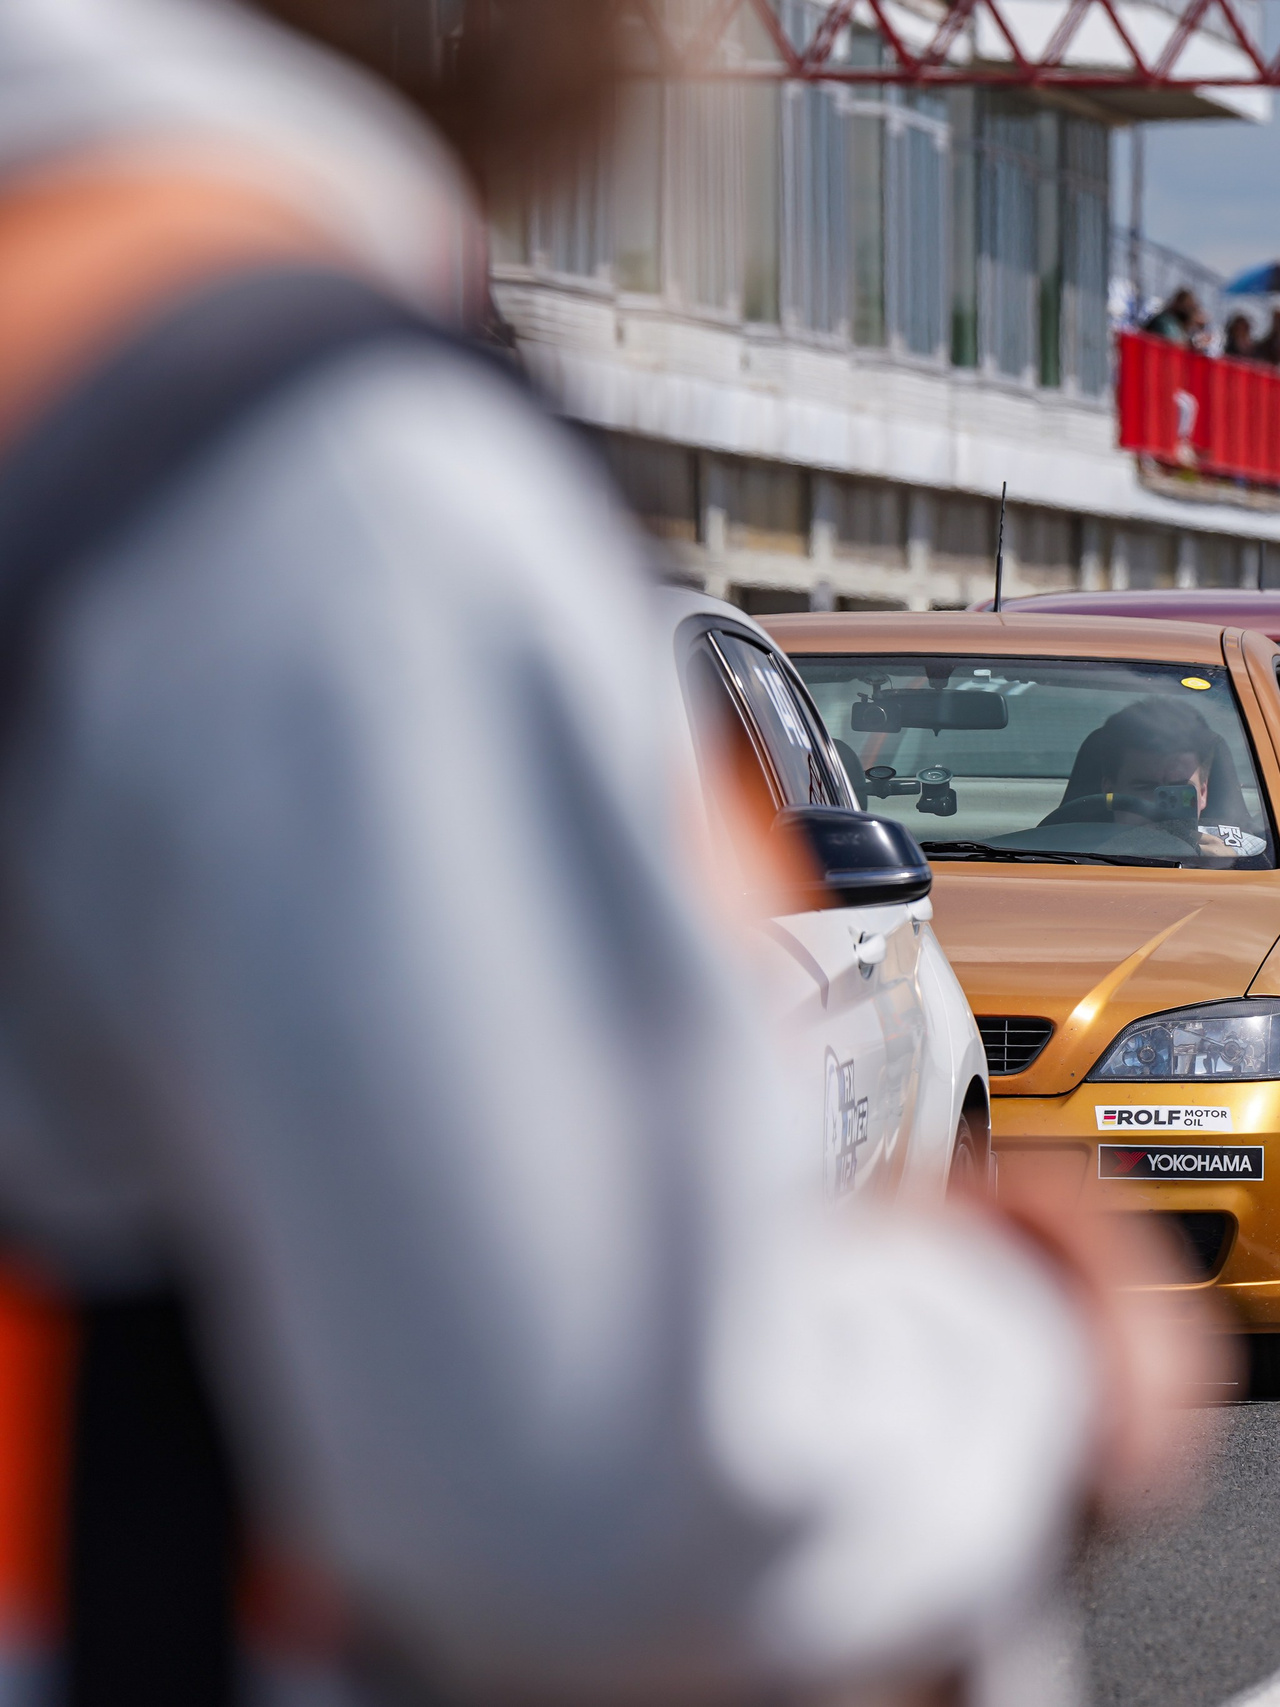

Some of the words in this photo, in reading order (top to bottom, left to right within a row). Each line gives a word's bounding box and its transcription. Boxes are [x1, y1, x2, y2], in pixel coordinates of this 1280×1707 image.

[1117, 1109, 1181, 1126] ROLF
[1184, 1109, 1228, 1119] MOTOR
[1184, 1118, 1204, 1127] OIL
[1147, 1154, 1252, 1172] YOKOHAMA
